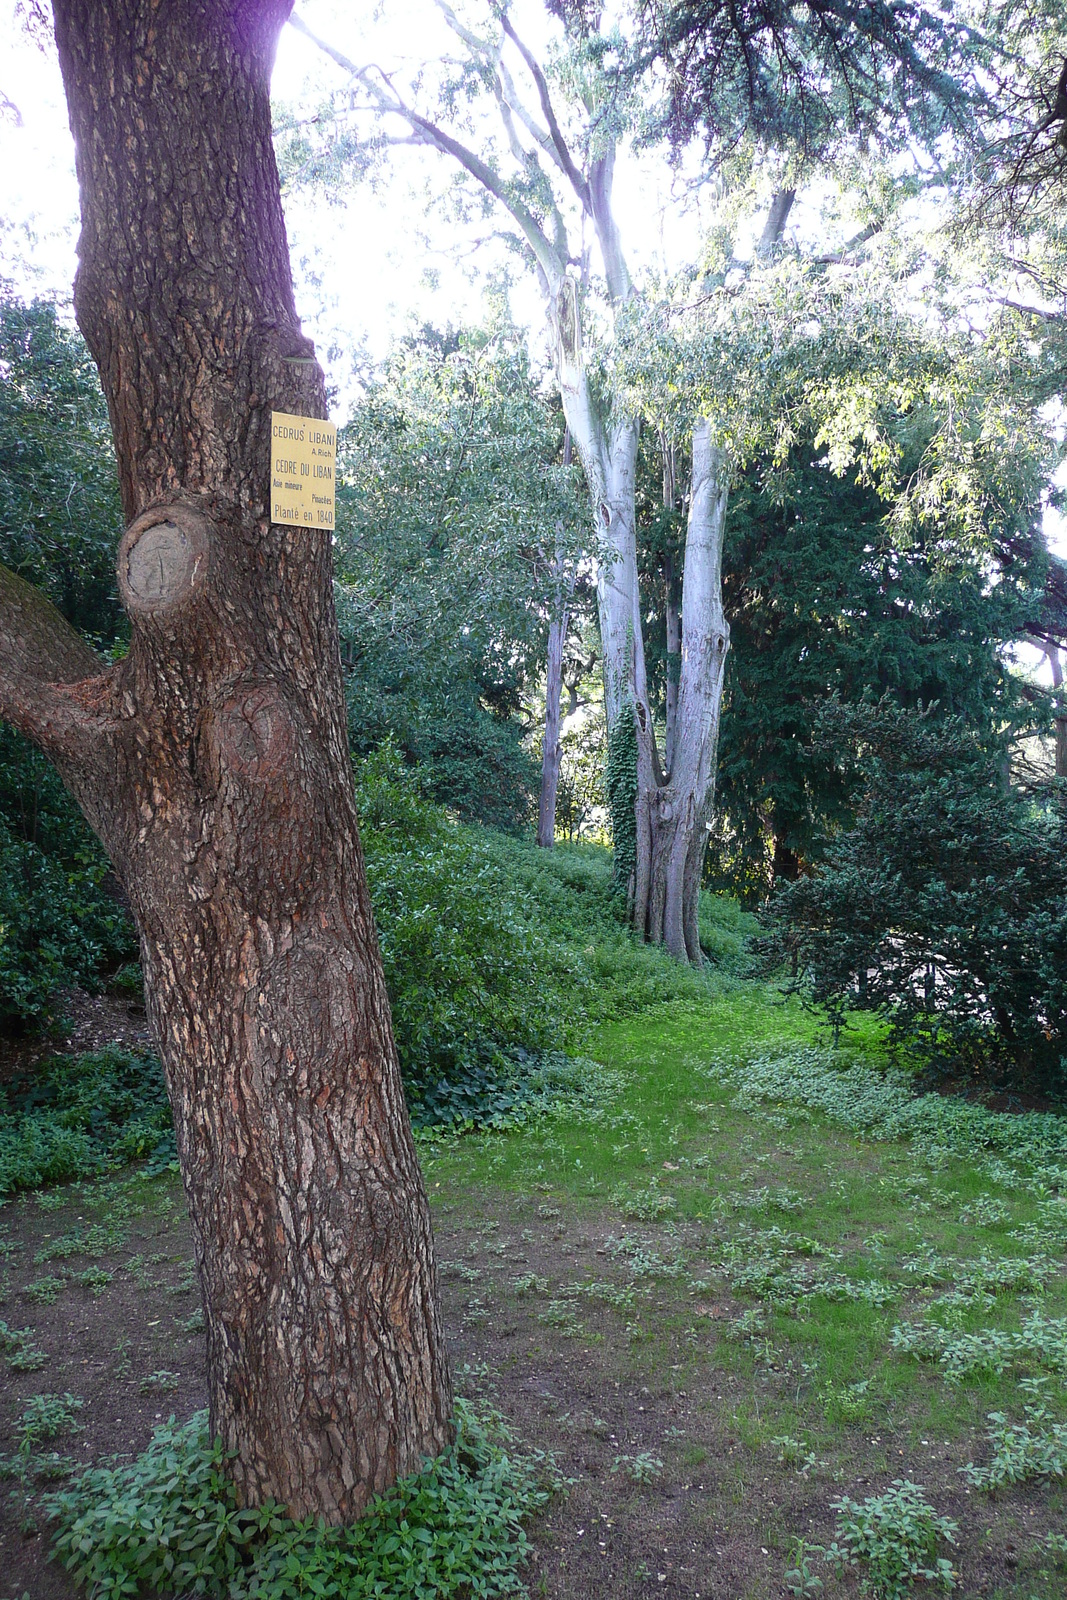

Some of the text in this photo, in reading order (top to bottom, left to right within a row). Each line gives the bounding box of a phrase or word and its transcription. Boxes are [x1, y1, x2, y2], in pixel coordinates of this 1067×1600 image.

[273, 425, 334, 445] CEDRUS LIBANI
[276, 459, 332, 480] CEDRE DU LIBAN
[272, 478, 303, 491] Asie mineure
[274, 503, 333, 524] Planté en 1840
